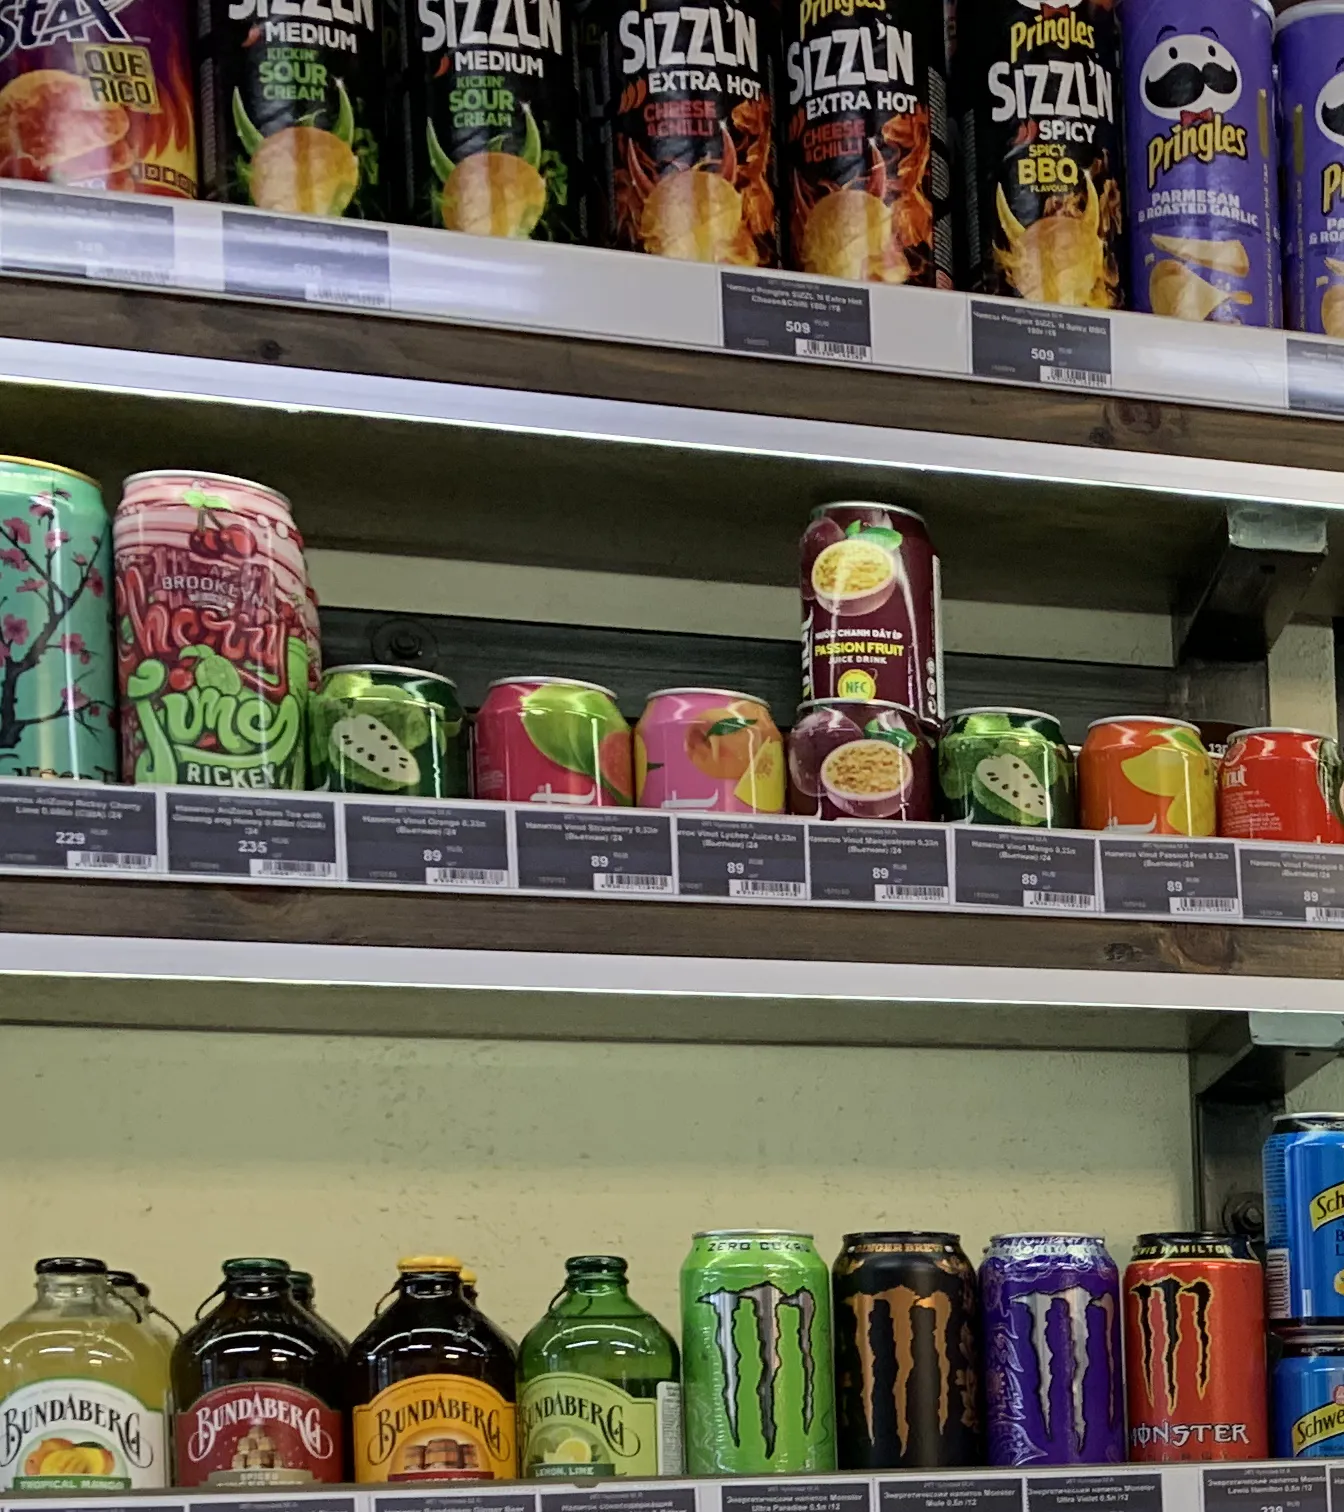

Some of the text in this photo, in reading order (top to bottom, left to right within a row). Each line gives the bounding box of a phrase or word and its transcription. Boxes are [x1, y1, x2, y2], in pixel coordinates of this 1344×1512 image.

[265, 22, 357, 53] MEDIUM
[619, 6, 759, 73] SIZZL'N
[1009, 12, 1096, 62] Pringles
[86, 50, 145, 77] QUE
[258, 61, 327, 86] SOUR
[455, 50, 544, 78] MEDIUM
[91, 77, 150, 105] RICO
[263, 85, 325, 101] CREAM
[648, 70, 761, 101] EXTRA HOT
[988, 55, 1114, 122] SIZZL'N
[448, 89, 515, 114] SOUR
[643, 100, 717, 120] CHEESE
[805, 90, 918, 120] EXTRA HOT
[454, 109, 513, 129] CREAM
[803, 120, 866, 145] CHEESE
[1038, 120, 1096, 144] SPICY
[1029, 143, 1066, 158] SPICY
[1146, 112, 1247, 190] Pringles
[1018, 157, 1078, 187] BBQ
[1151, 190, 1240, 209] PARMESAN
[785, 320, 811, 334] 509
[1030, 348, 1054, 361] 509
[814, 641, 904, 657] PASSION FRUIT
[185, 762, 276, 790] RICKEY
[55, 832, 85, 846] 229
[238, 840, 268, 854] 235
[0, 1394, 154, 1469] BUNDABERG
[189, 1393, 334, 1461] BUNDABERG
[367, 1398, 515, 1467] BUNDABERG
